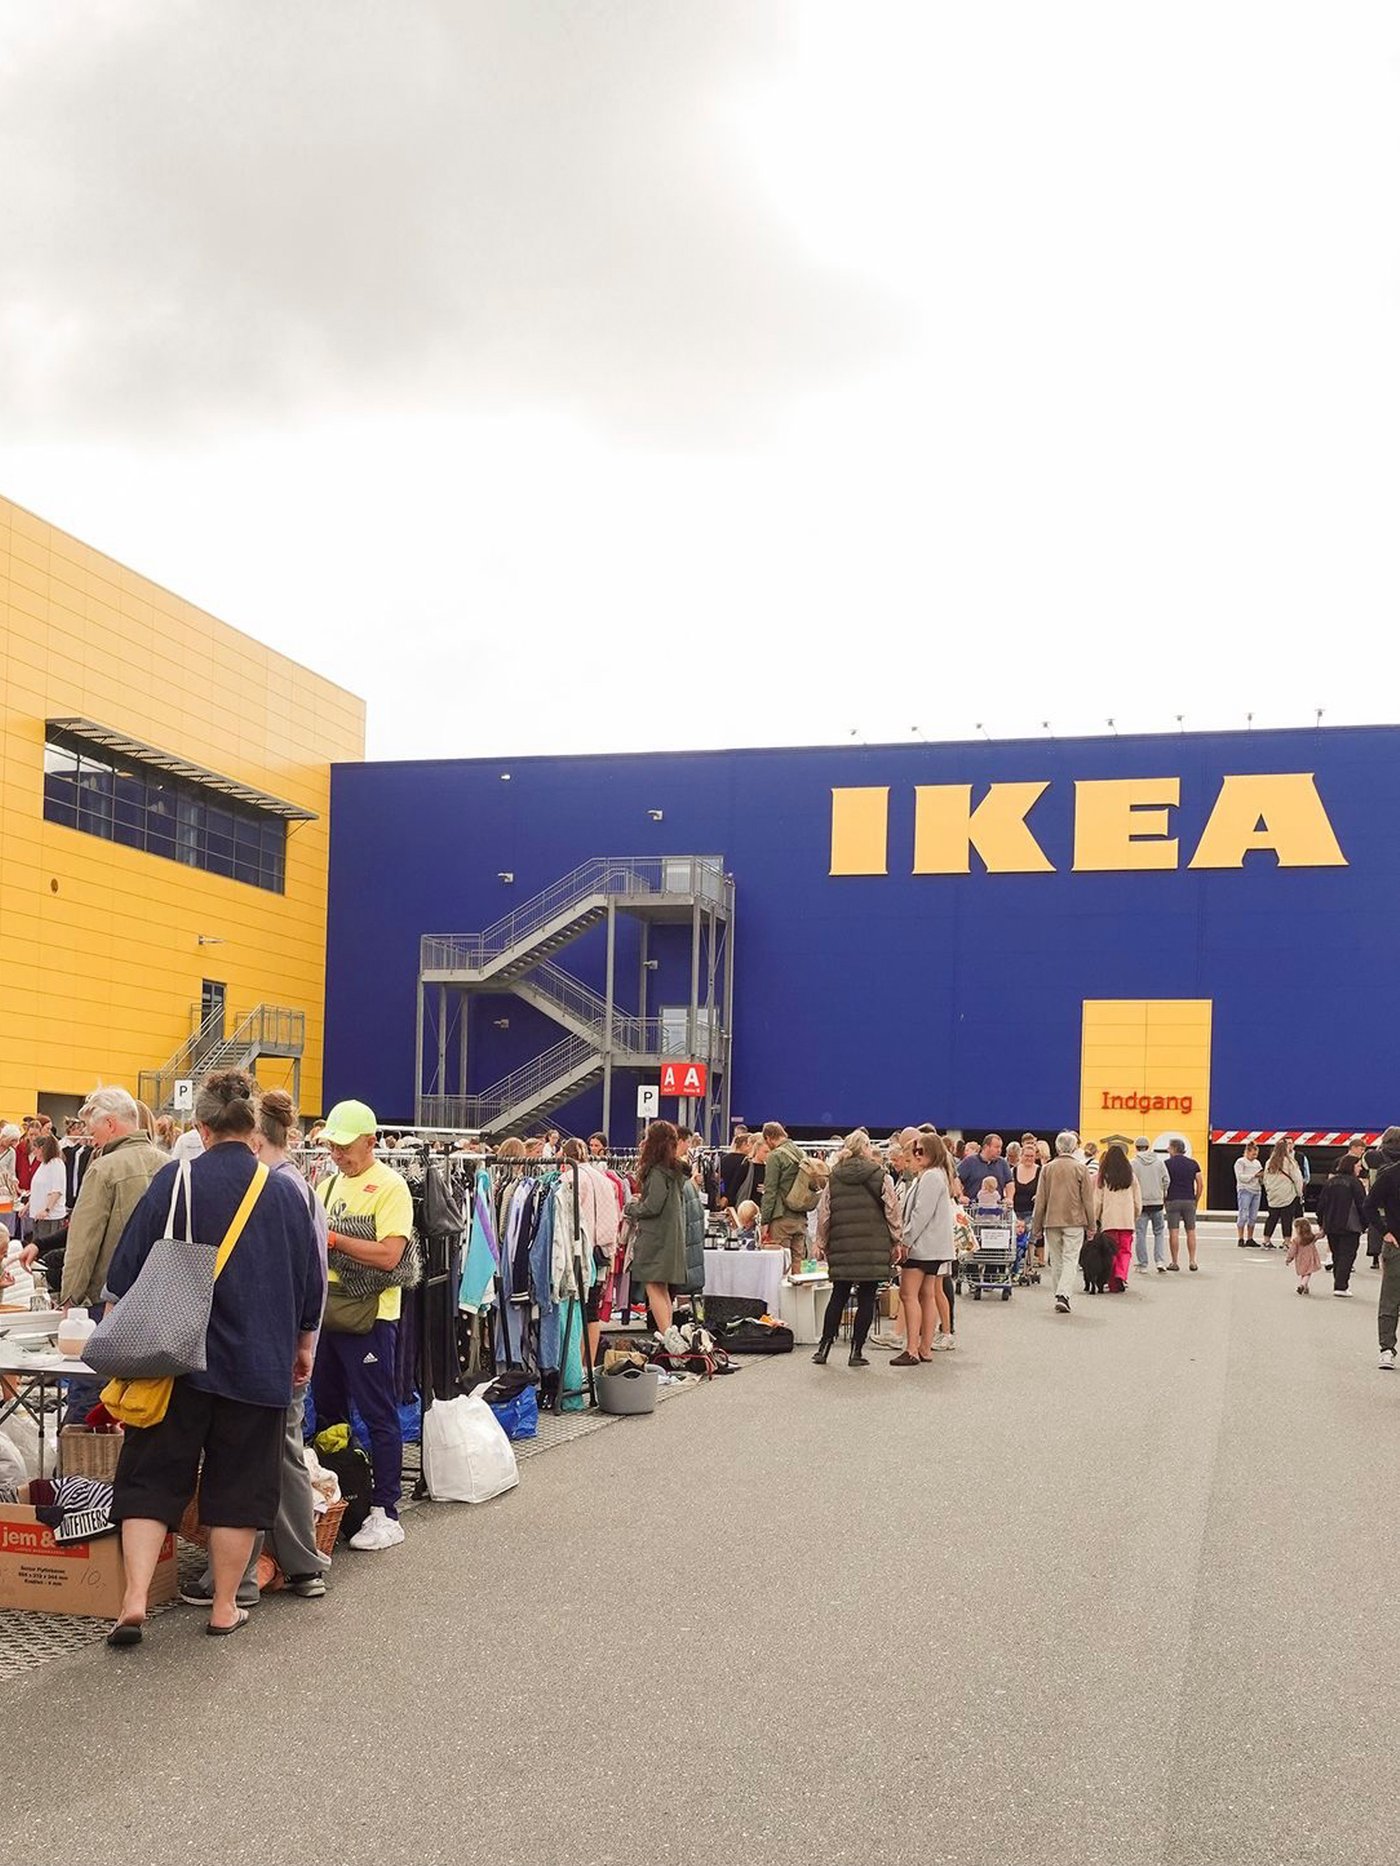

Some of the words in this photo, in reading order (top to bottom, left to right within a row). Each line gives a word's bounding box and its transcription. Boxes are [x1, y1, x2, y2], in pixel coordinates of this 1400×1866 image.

[828, 772, 1350, 877] IKEA
[664, 1067, 675, 1086] A
[684, 1067, 700, 1087] A
[179, 1085, 188, 1097] P
[643, 1091, 653, 1104] P
[1101, 1091, 1192, 1114] Indgang
[2, 1526, 37, 1548] jem
